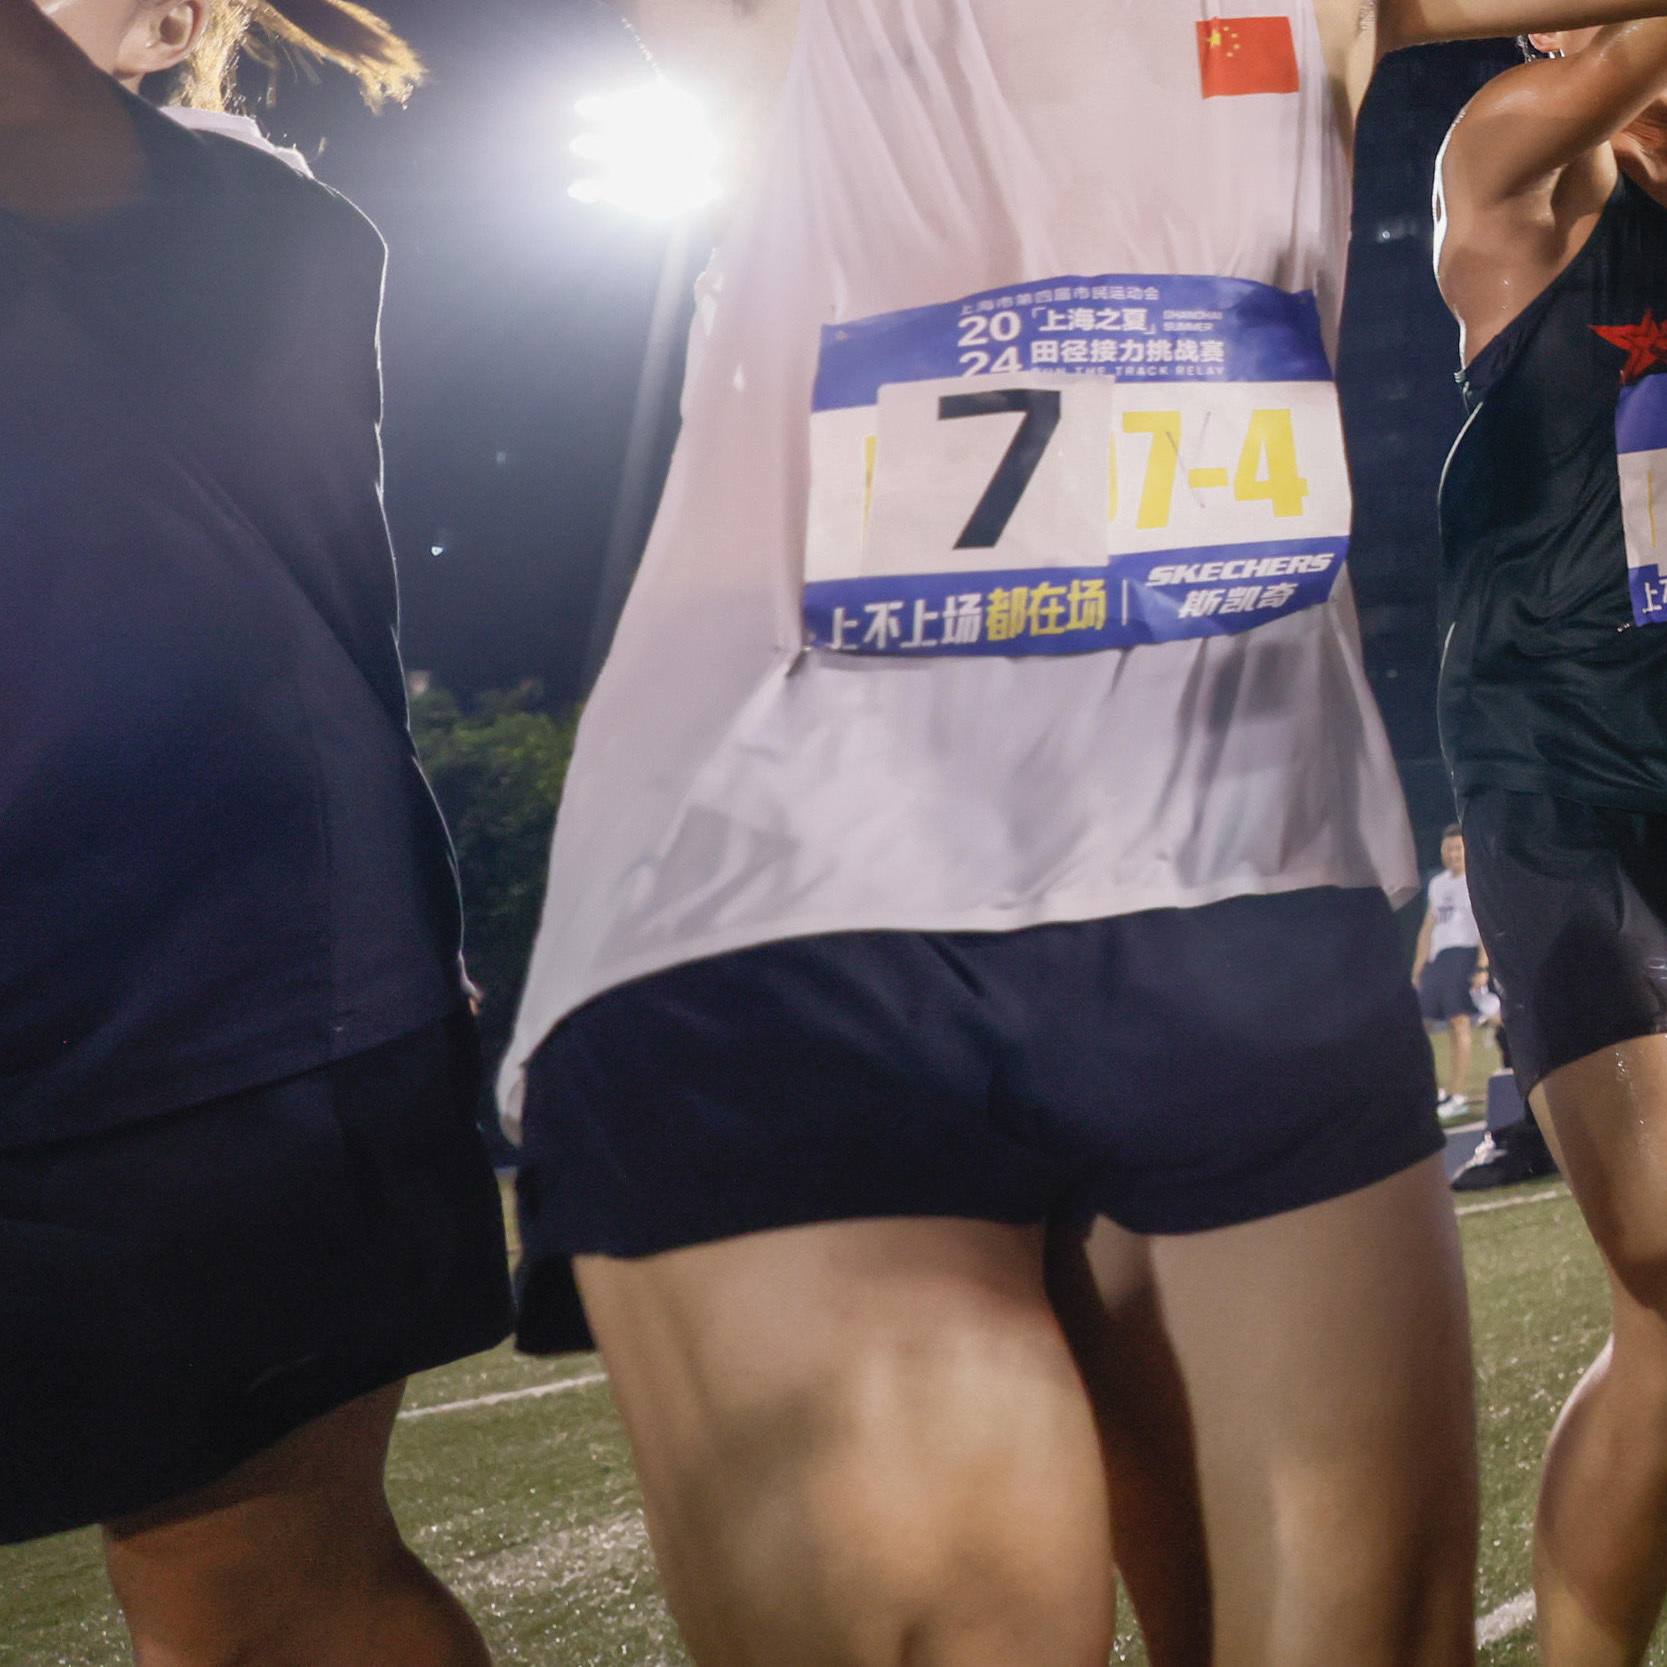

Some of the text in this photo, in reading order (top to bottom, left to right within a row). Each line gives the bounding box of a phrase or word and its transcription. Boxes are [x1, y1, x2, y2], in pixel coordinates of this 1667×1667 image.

[957, 310, 1022, 347] 20
[957, 346, 1022, 378] 24
[1031, 338, 1225, 364] 田径接力挑战赛
[937, 388, 1062, 551] 7
[1145, 552, 1335, 587] SKECHERS
[832, 578, 1106, 651] 上不上场都在场
[1177, 581, 1299, 620] 斯凯奇
